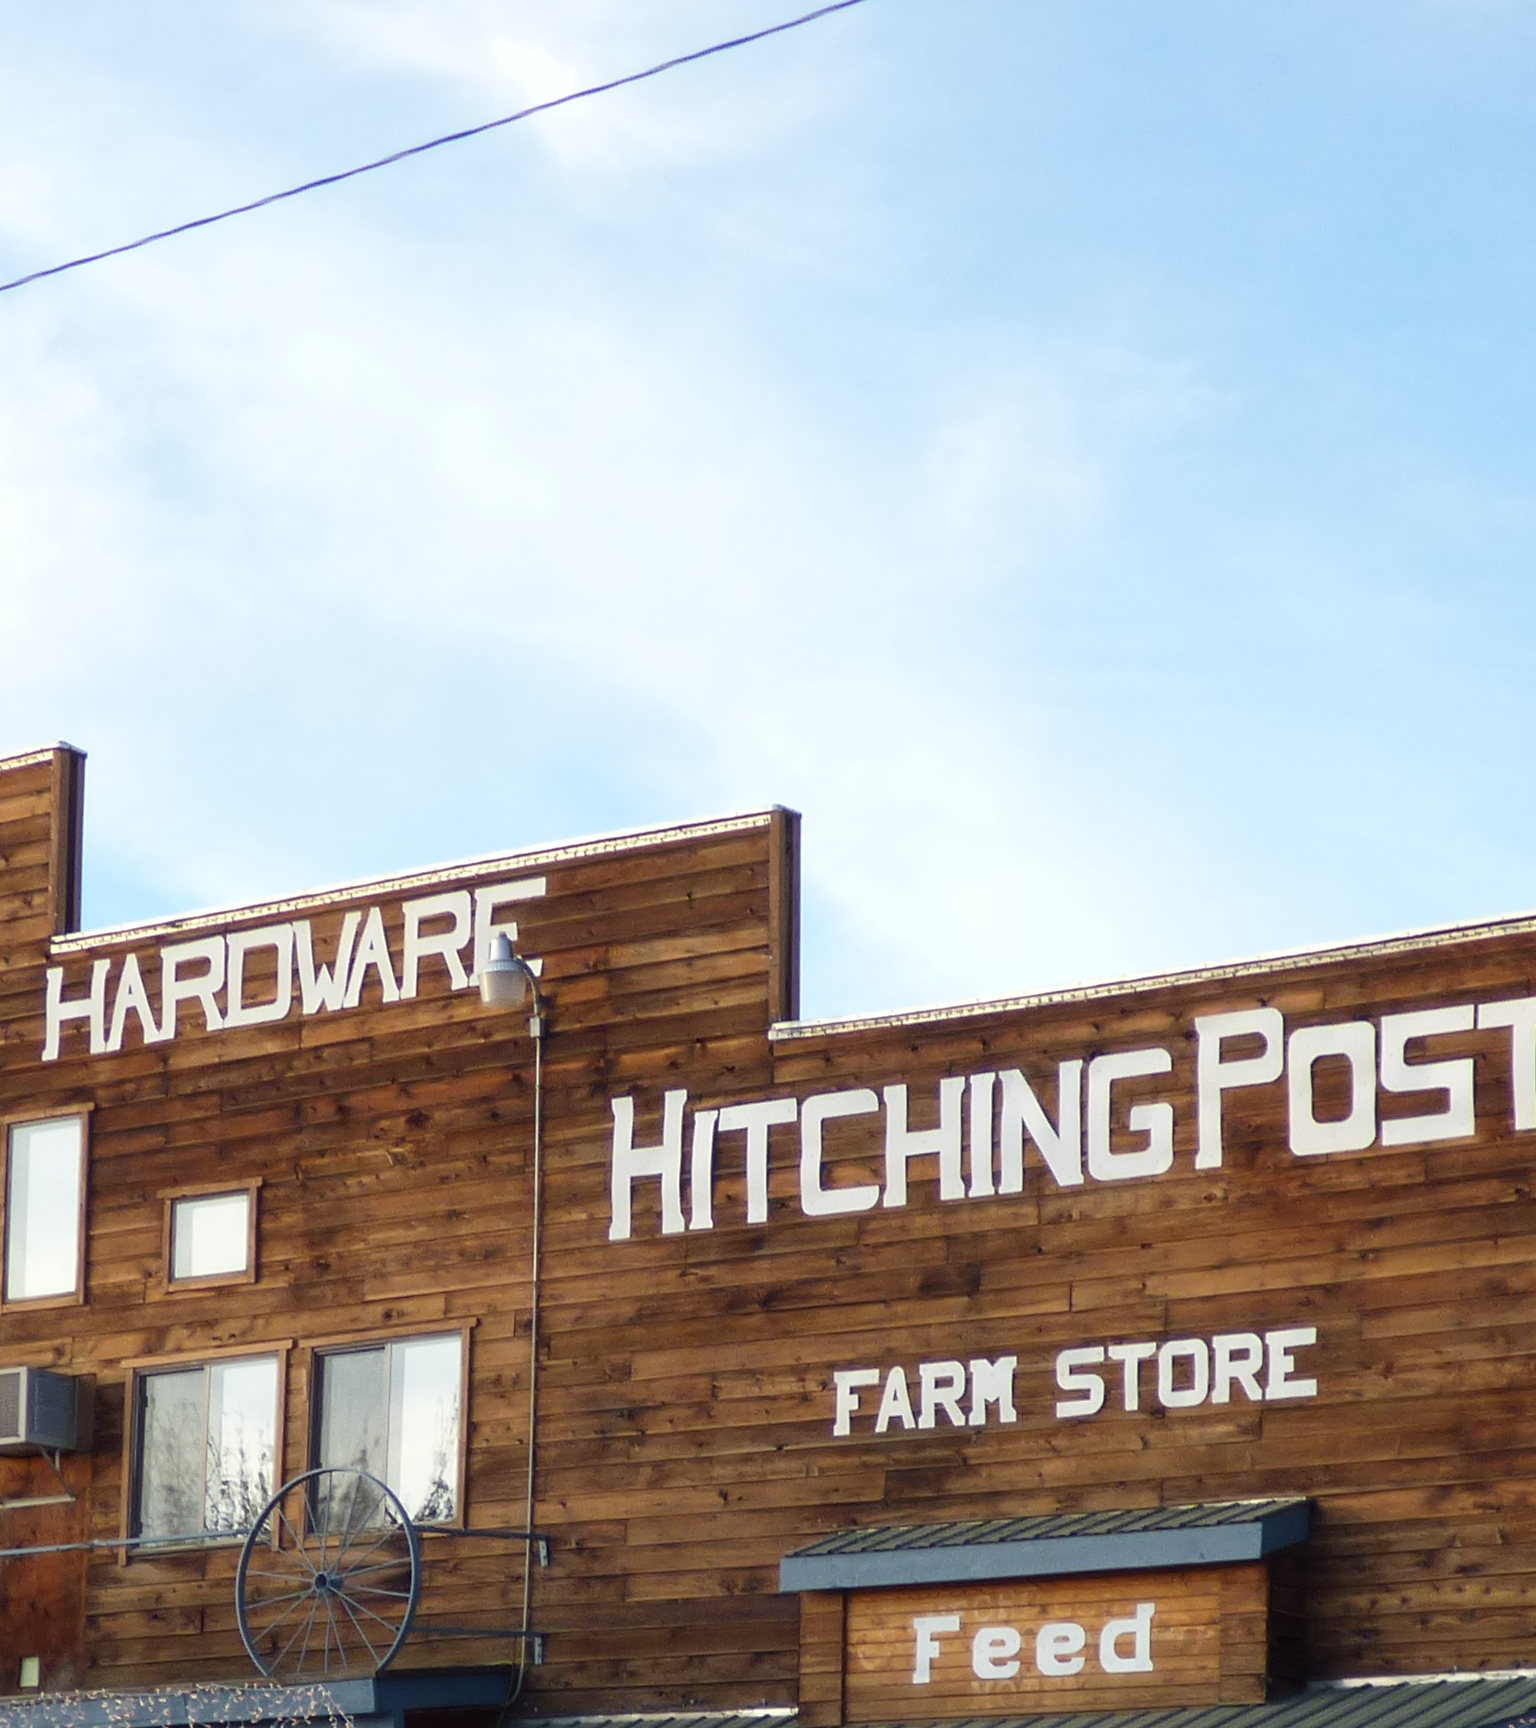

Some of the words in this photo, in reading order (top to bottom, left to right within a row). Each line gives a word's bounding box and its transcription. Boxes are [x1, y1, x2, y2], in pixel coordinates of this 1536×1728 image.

[41, 877, 547, 1062] HARDWARE
[609, 1048, 1174, 1242] HITCHING
[833, 1355, 1017, 1437] FARM
[1055, 1327, 1317, 1419] STORE
[912, 1602, 1156, 1685] Feed
